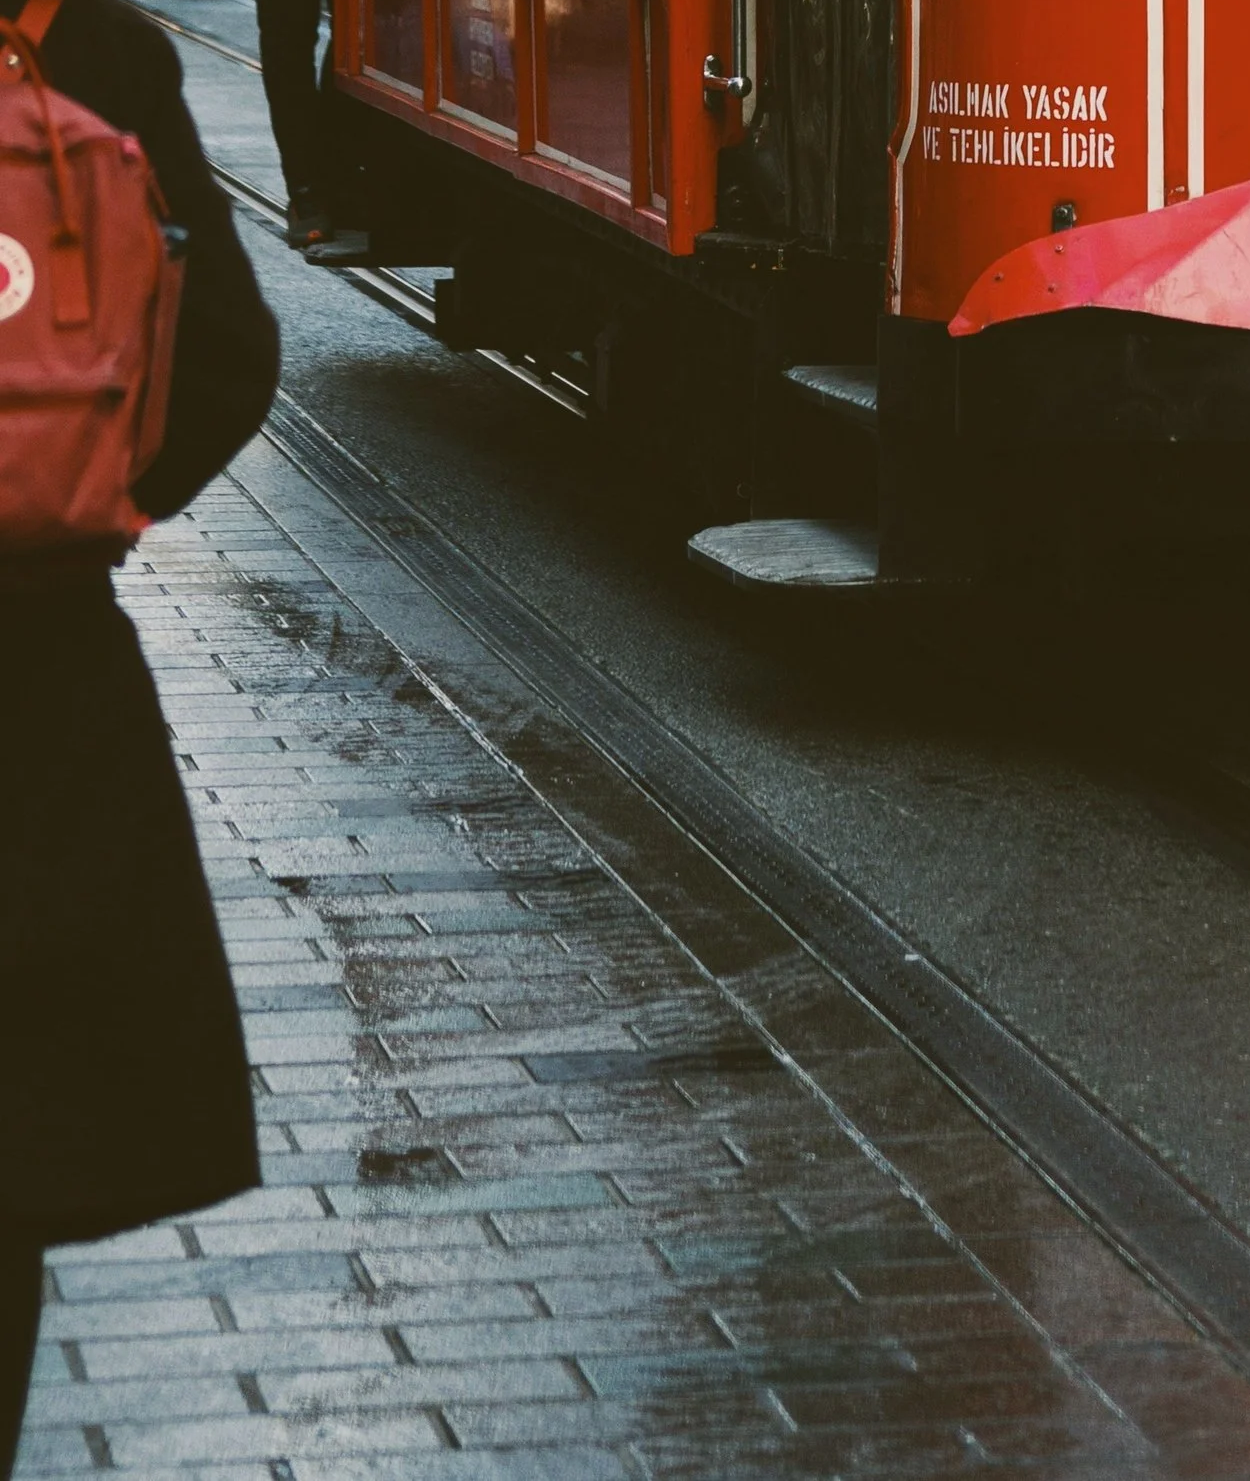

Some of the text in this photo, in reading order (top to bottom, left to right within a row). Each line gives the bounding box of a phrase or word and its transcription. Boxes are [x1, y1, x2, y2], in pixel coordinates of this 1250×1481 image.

[929, 81, 1108, 122] ASILMAK YASAK
[922, 126, 1115, 169] VE TEHLİKELİDİR
